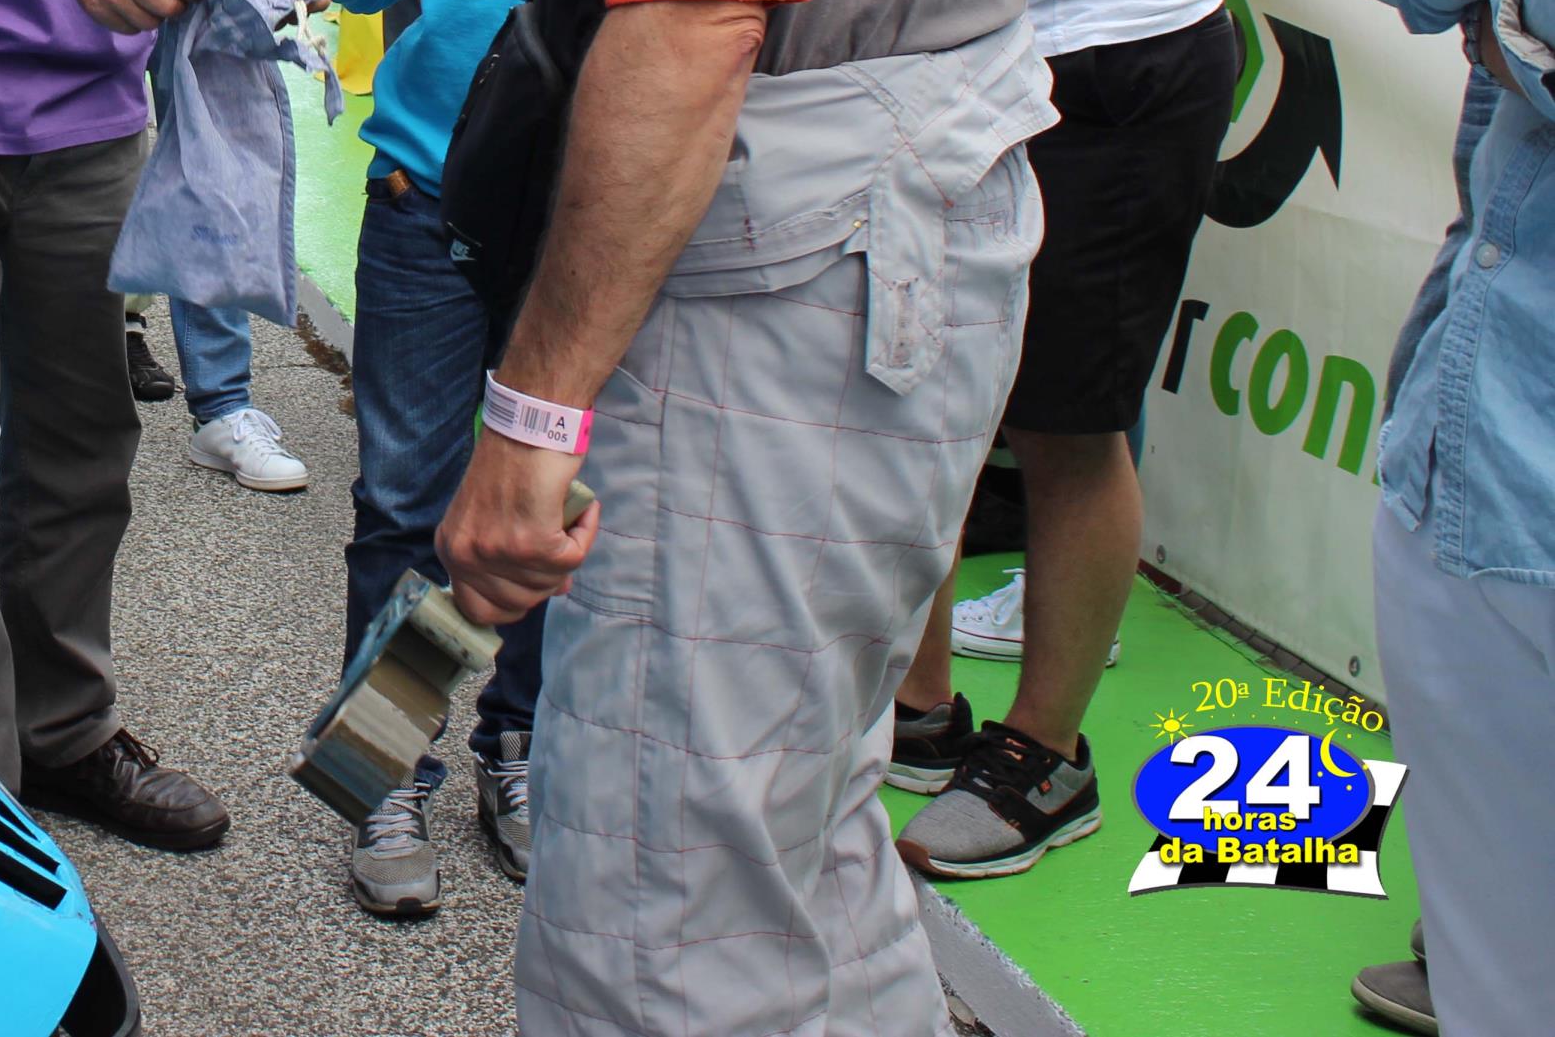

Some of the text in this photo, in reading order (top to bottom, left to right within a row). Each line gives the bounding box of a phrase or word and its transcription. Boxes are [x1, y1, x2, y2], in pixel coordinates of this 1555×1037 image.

[1161, 299, 1382, 486] rcon
[555, 416, 566, 429] A
[547, 429, 568, 443] 005
